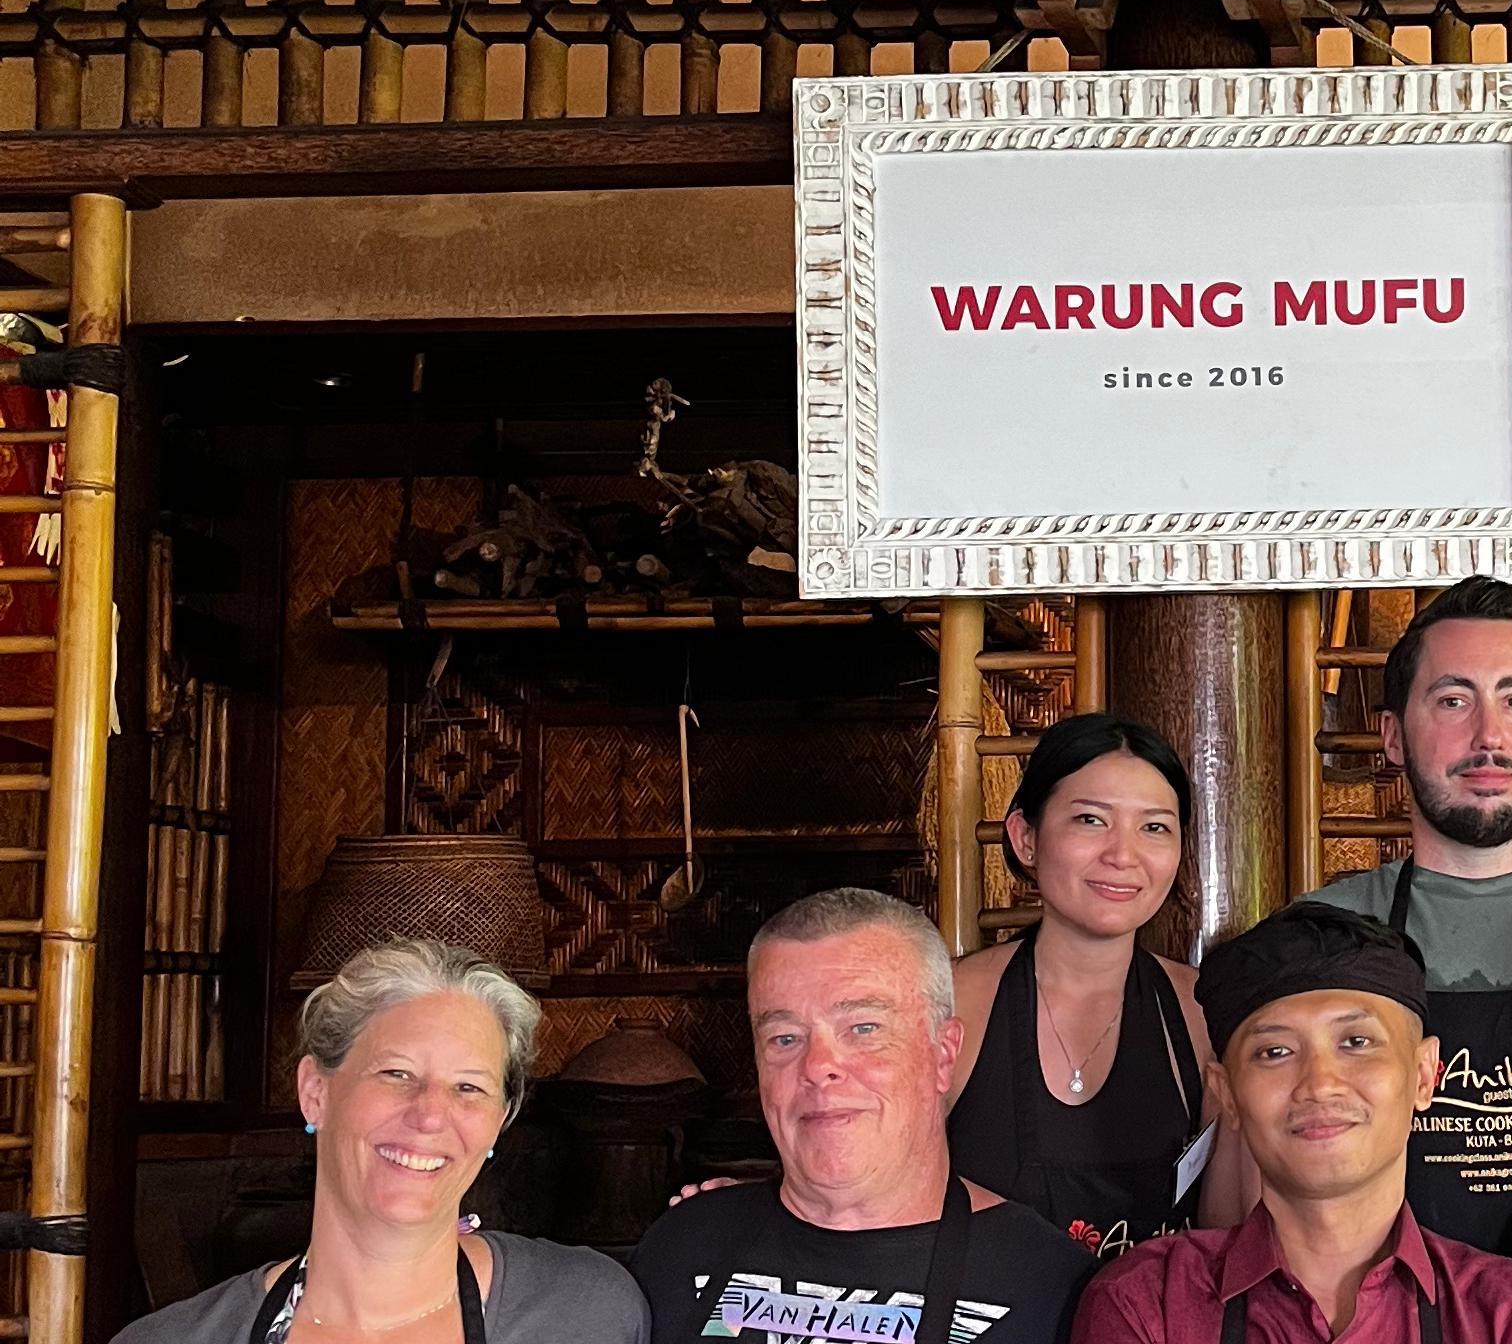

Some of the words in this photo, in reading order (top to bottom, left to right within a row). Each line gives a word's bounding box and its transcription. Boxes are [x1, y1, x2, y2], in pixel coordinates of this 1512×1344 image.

[930, 281, 1244, 331] WARUNG
[1273, 277, 1465, 327] MUFU
[1103, 366, 1193, 390] since
[1208, 366, 1285, 388] 2016
[1484, 1088, 1512, 1103] guest
[1411, 1117, 1473, 1132] ALINESE
[744, 1293, 798, 1324] VAN
[806, 1304, 915, 1340] HALEN
